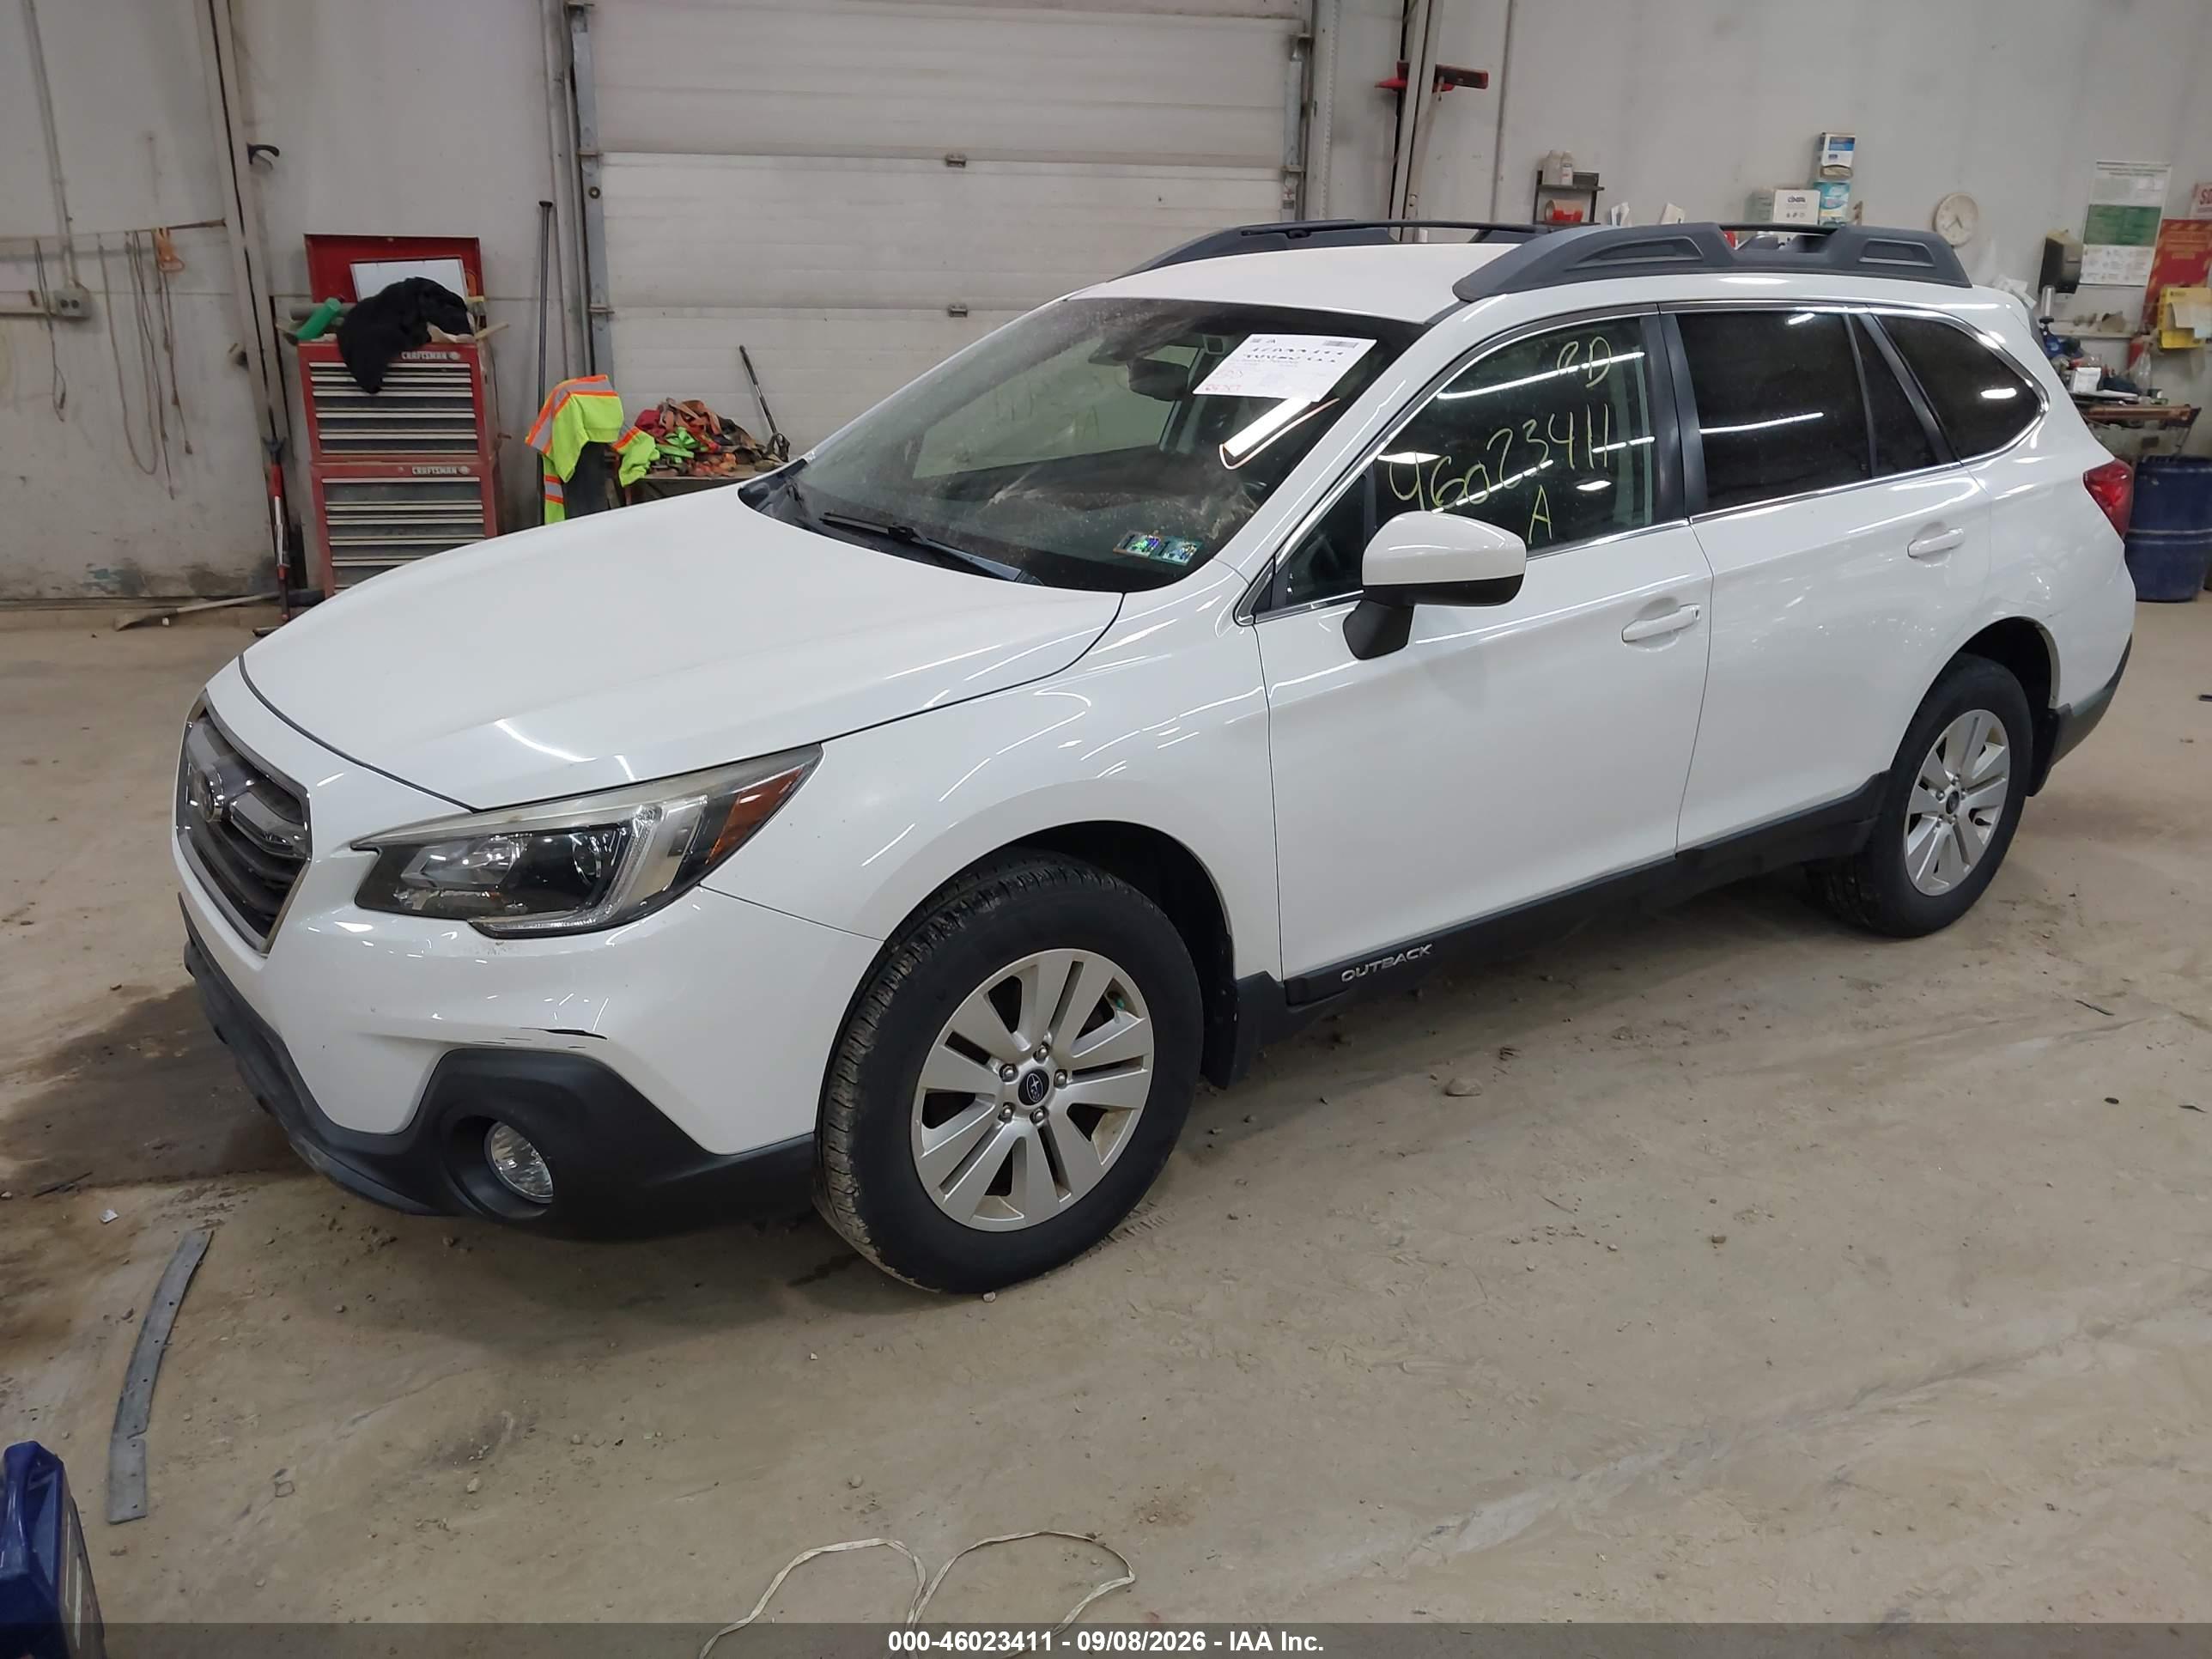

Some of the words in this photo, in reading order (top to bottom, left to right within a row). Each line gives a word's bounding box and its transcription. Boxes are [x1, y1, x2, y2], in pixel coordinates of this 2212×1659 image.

[411, 466, 458, 475] CRAFTSMAN
[1389, 403, 1609, 511] 46023411
[1527, 484, 1553, 545] A
[1340, 943, 1432, 982] OUTBACK
